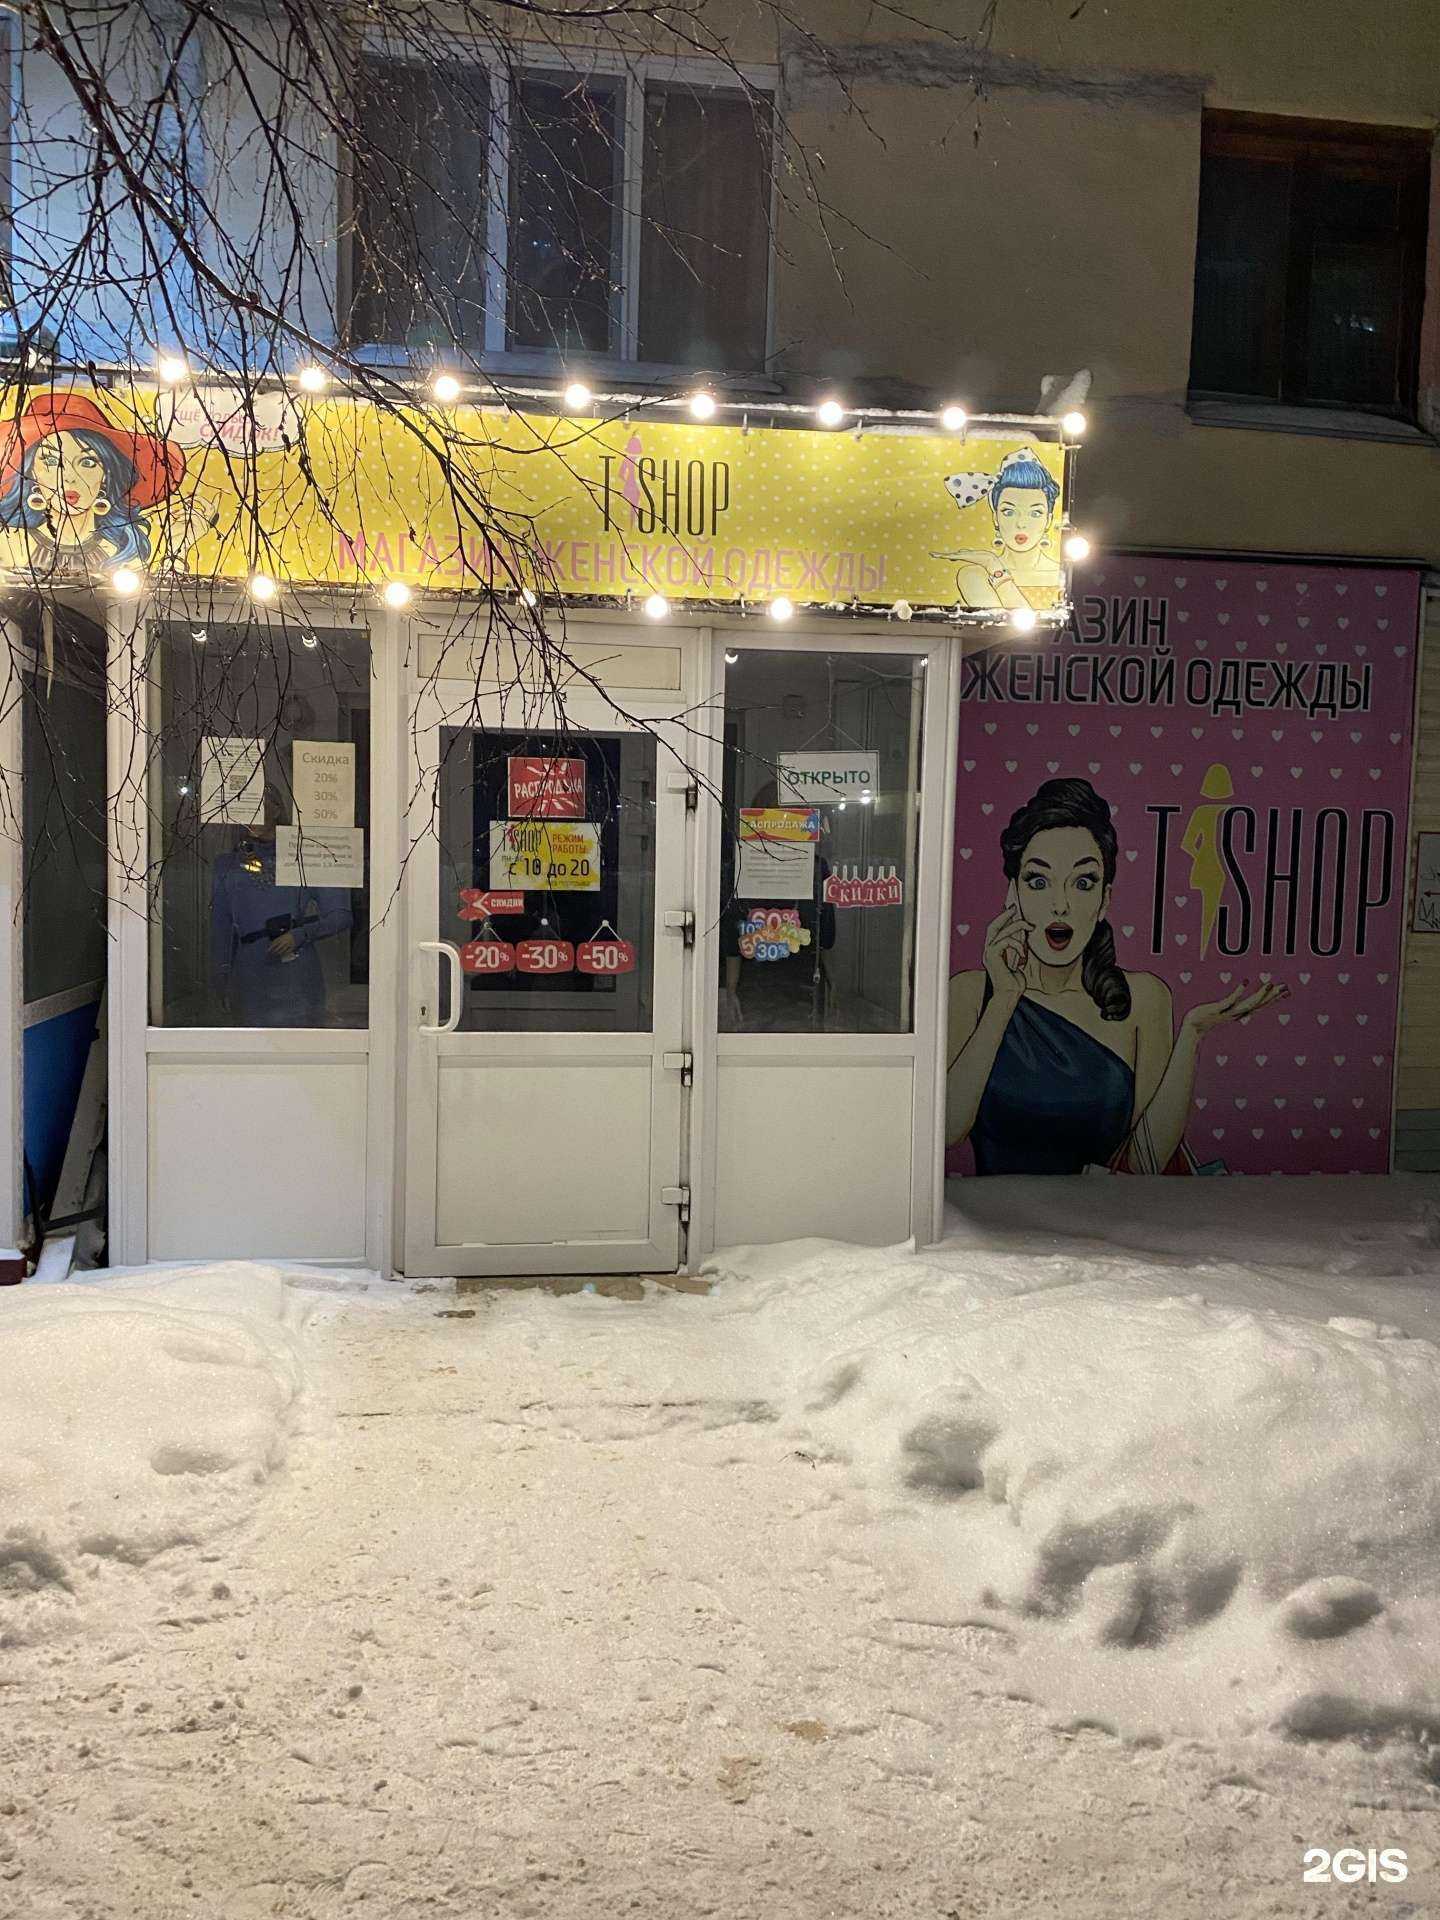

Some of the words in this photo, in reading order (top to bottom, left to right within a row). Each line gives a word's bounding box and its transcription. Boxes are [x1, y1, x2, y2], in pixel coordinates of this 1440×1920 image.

[534, 538, 716, 587] ЖЕНСКОЙ
[723, 547, 887, 594] ОДЕЖДЫ
[961, 646, 1176, 706] ЖЕНСКОЙ
[1184, 658, 1374, 720] ОДЕЖДЫ
[302, 752, 350, 767] Скидка
[313, 772, 338, 784] 20%
[786, 769, 871, 786] ОТКРЫТО
[313, 791, 338, 802] 30%
[313, 809, 338, 820] 50%
[552, 833, 584, 845] РЕЖИМ
[552, 844, 588, 855] РАБОТЫ
[524, 858, 542, 876] 10
[547, 863, 567, 878] до
[570, 859, 590, 876] 20
[827, 884, 899, 904] СКИДКИ
[465, 946, 510, 969] -20%
[521, 946, 568, 970] -30%
[583, 946, 629, 970] -50%
[756, 943, 790, 959] 30%
